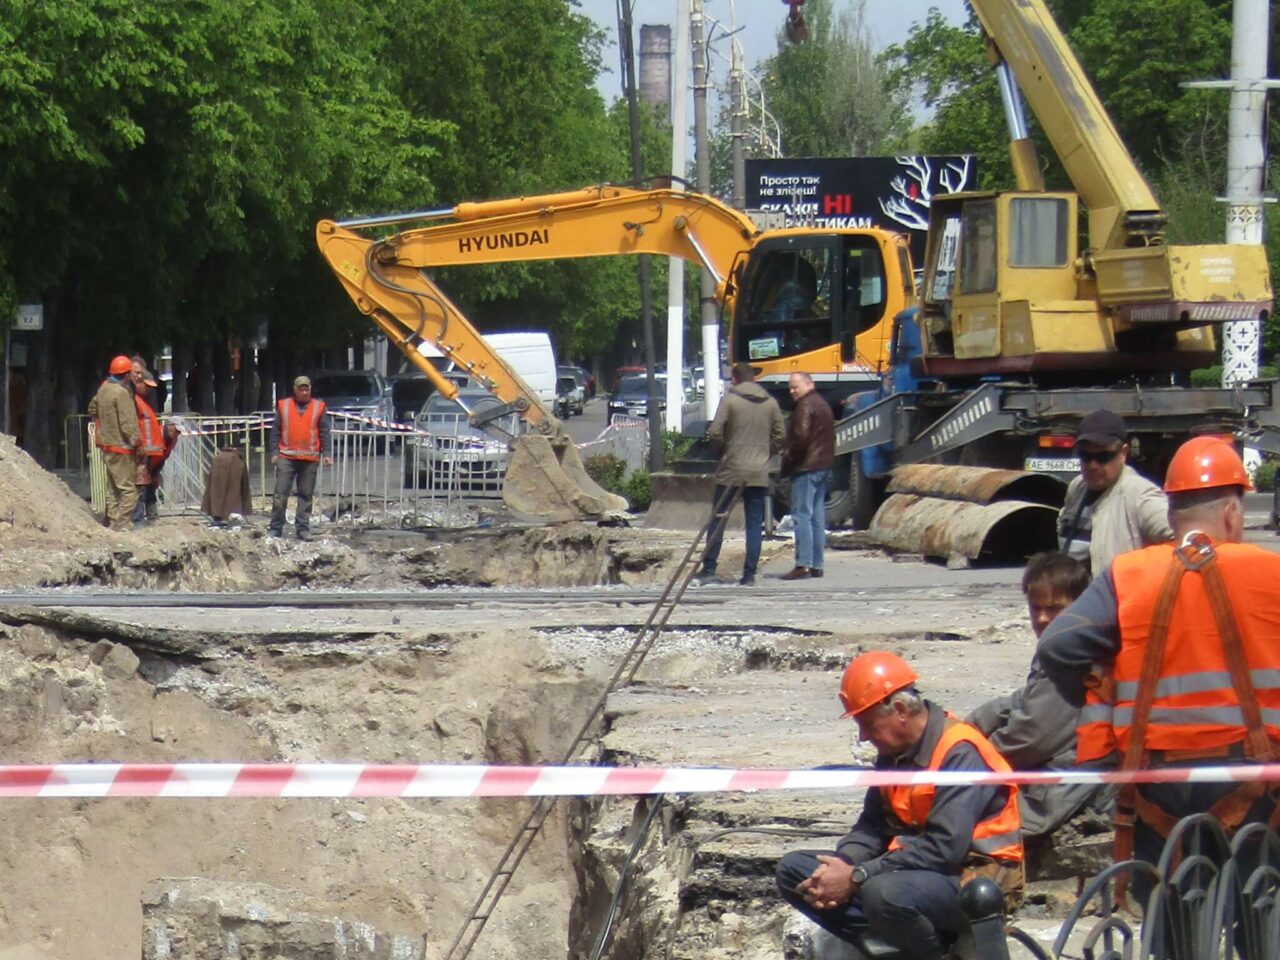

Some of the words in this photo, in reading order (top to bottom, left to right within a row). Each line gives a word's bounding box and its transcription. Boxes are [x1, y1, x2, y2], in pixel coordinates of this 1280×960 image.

[760, 176, 800, 187] Просто
[801, 176, 820, 184] так
[760, 188, 774, 196] не
[824, 195, 851, 214] НІ
[459, 229, 549, 253] HYUNDAI
